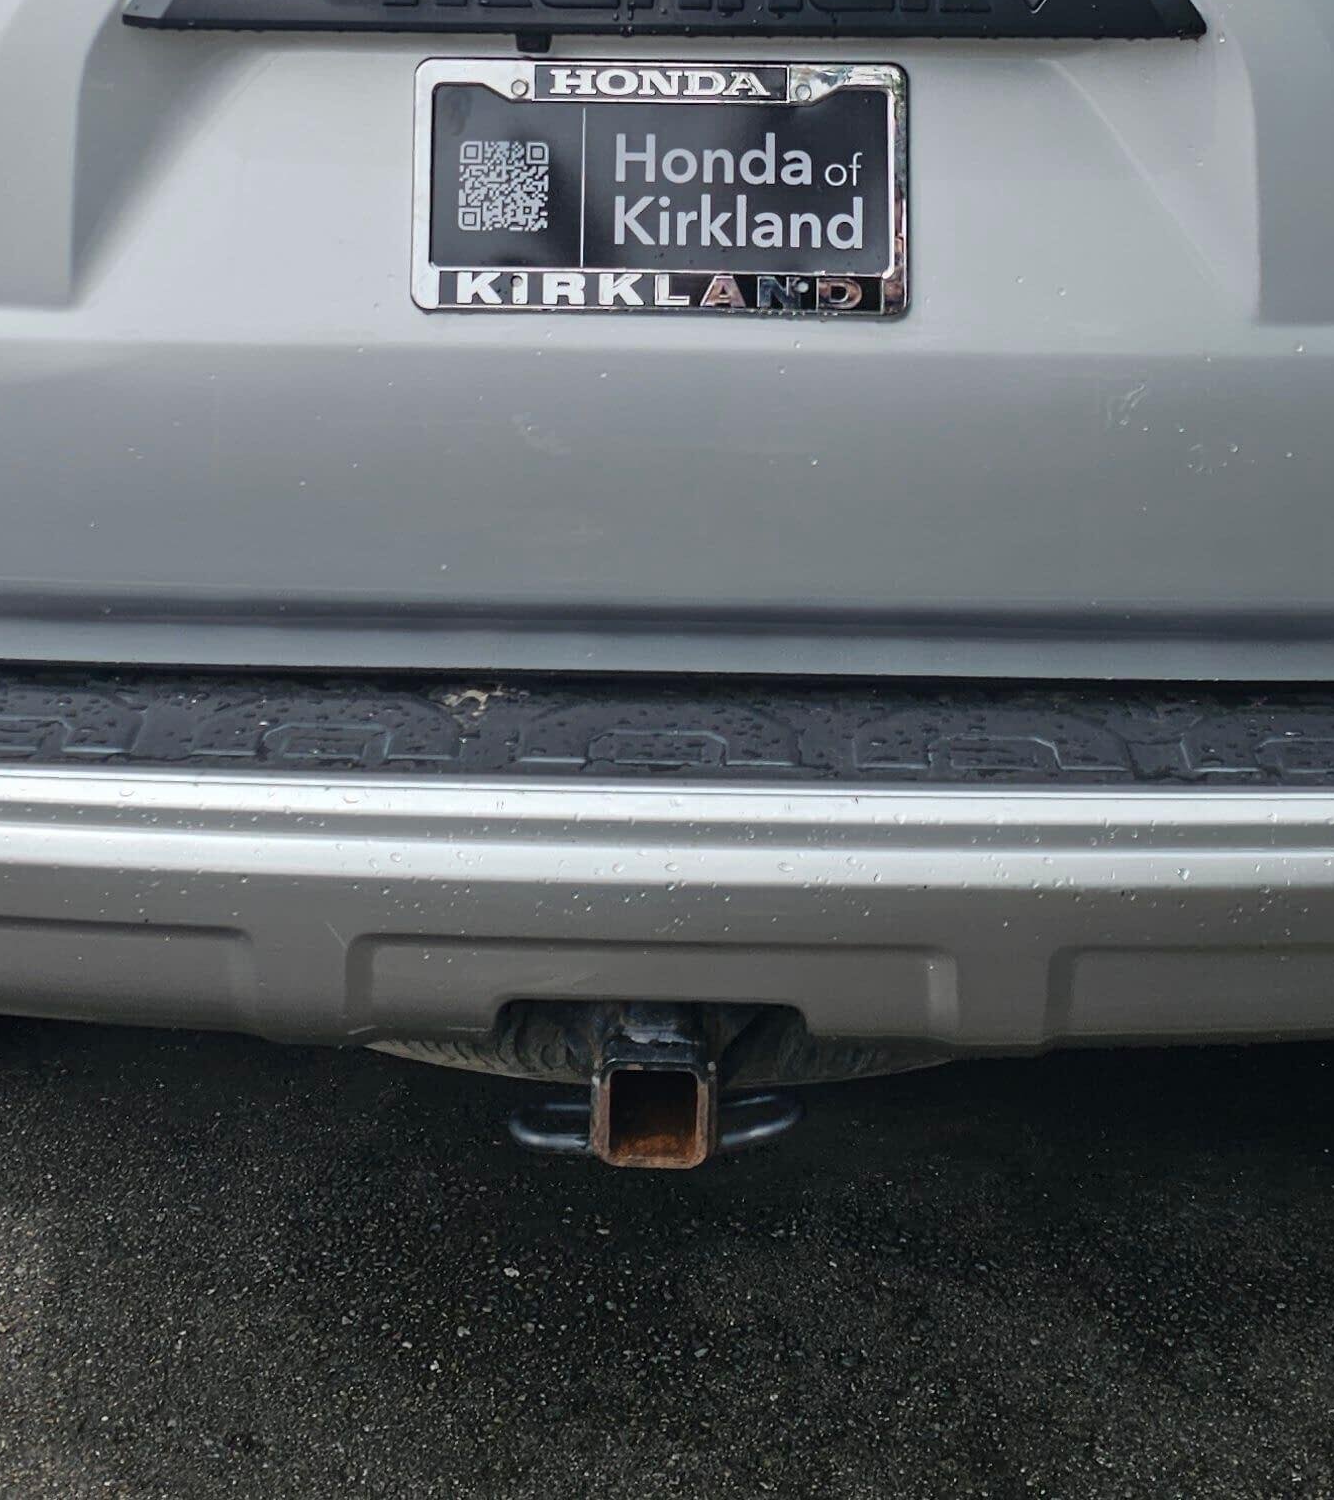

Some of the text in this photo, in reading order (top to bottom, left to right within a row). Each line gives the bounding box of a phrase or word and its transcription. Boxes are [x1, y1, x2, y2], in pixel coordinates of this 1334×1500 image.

[549, 67, 771, 97] HONDA
[615, 133, 863, 187] Honda of
[613, 194, 864, 250] Kirkland
[455, 271, 864, 309] KIRKLAND
